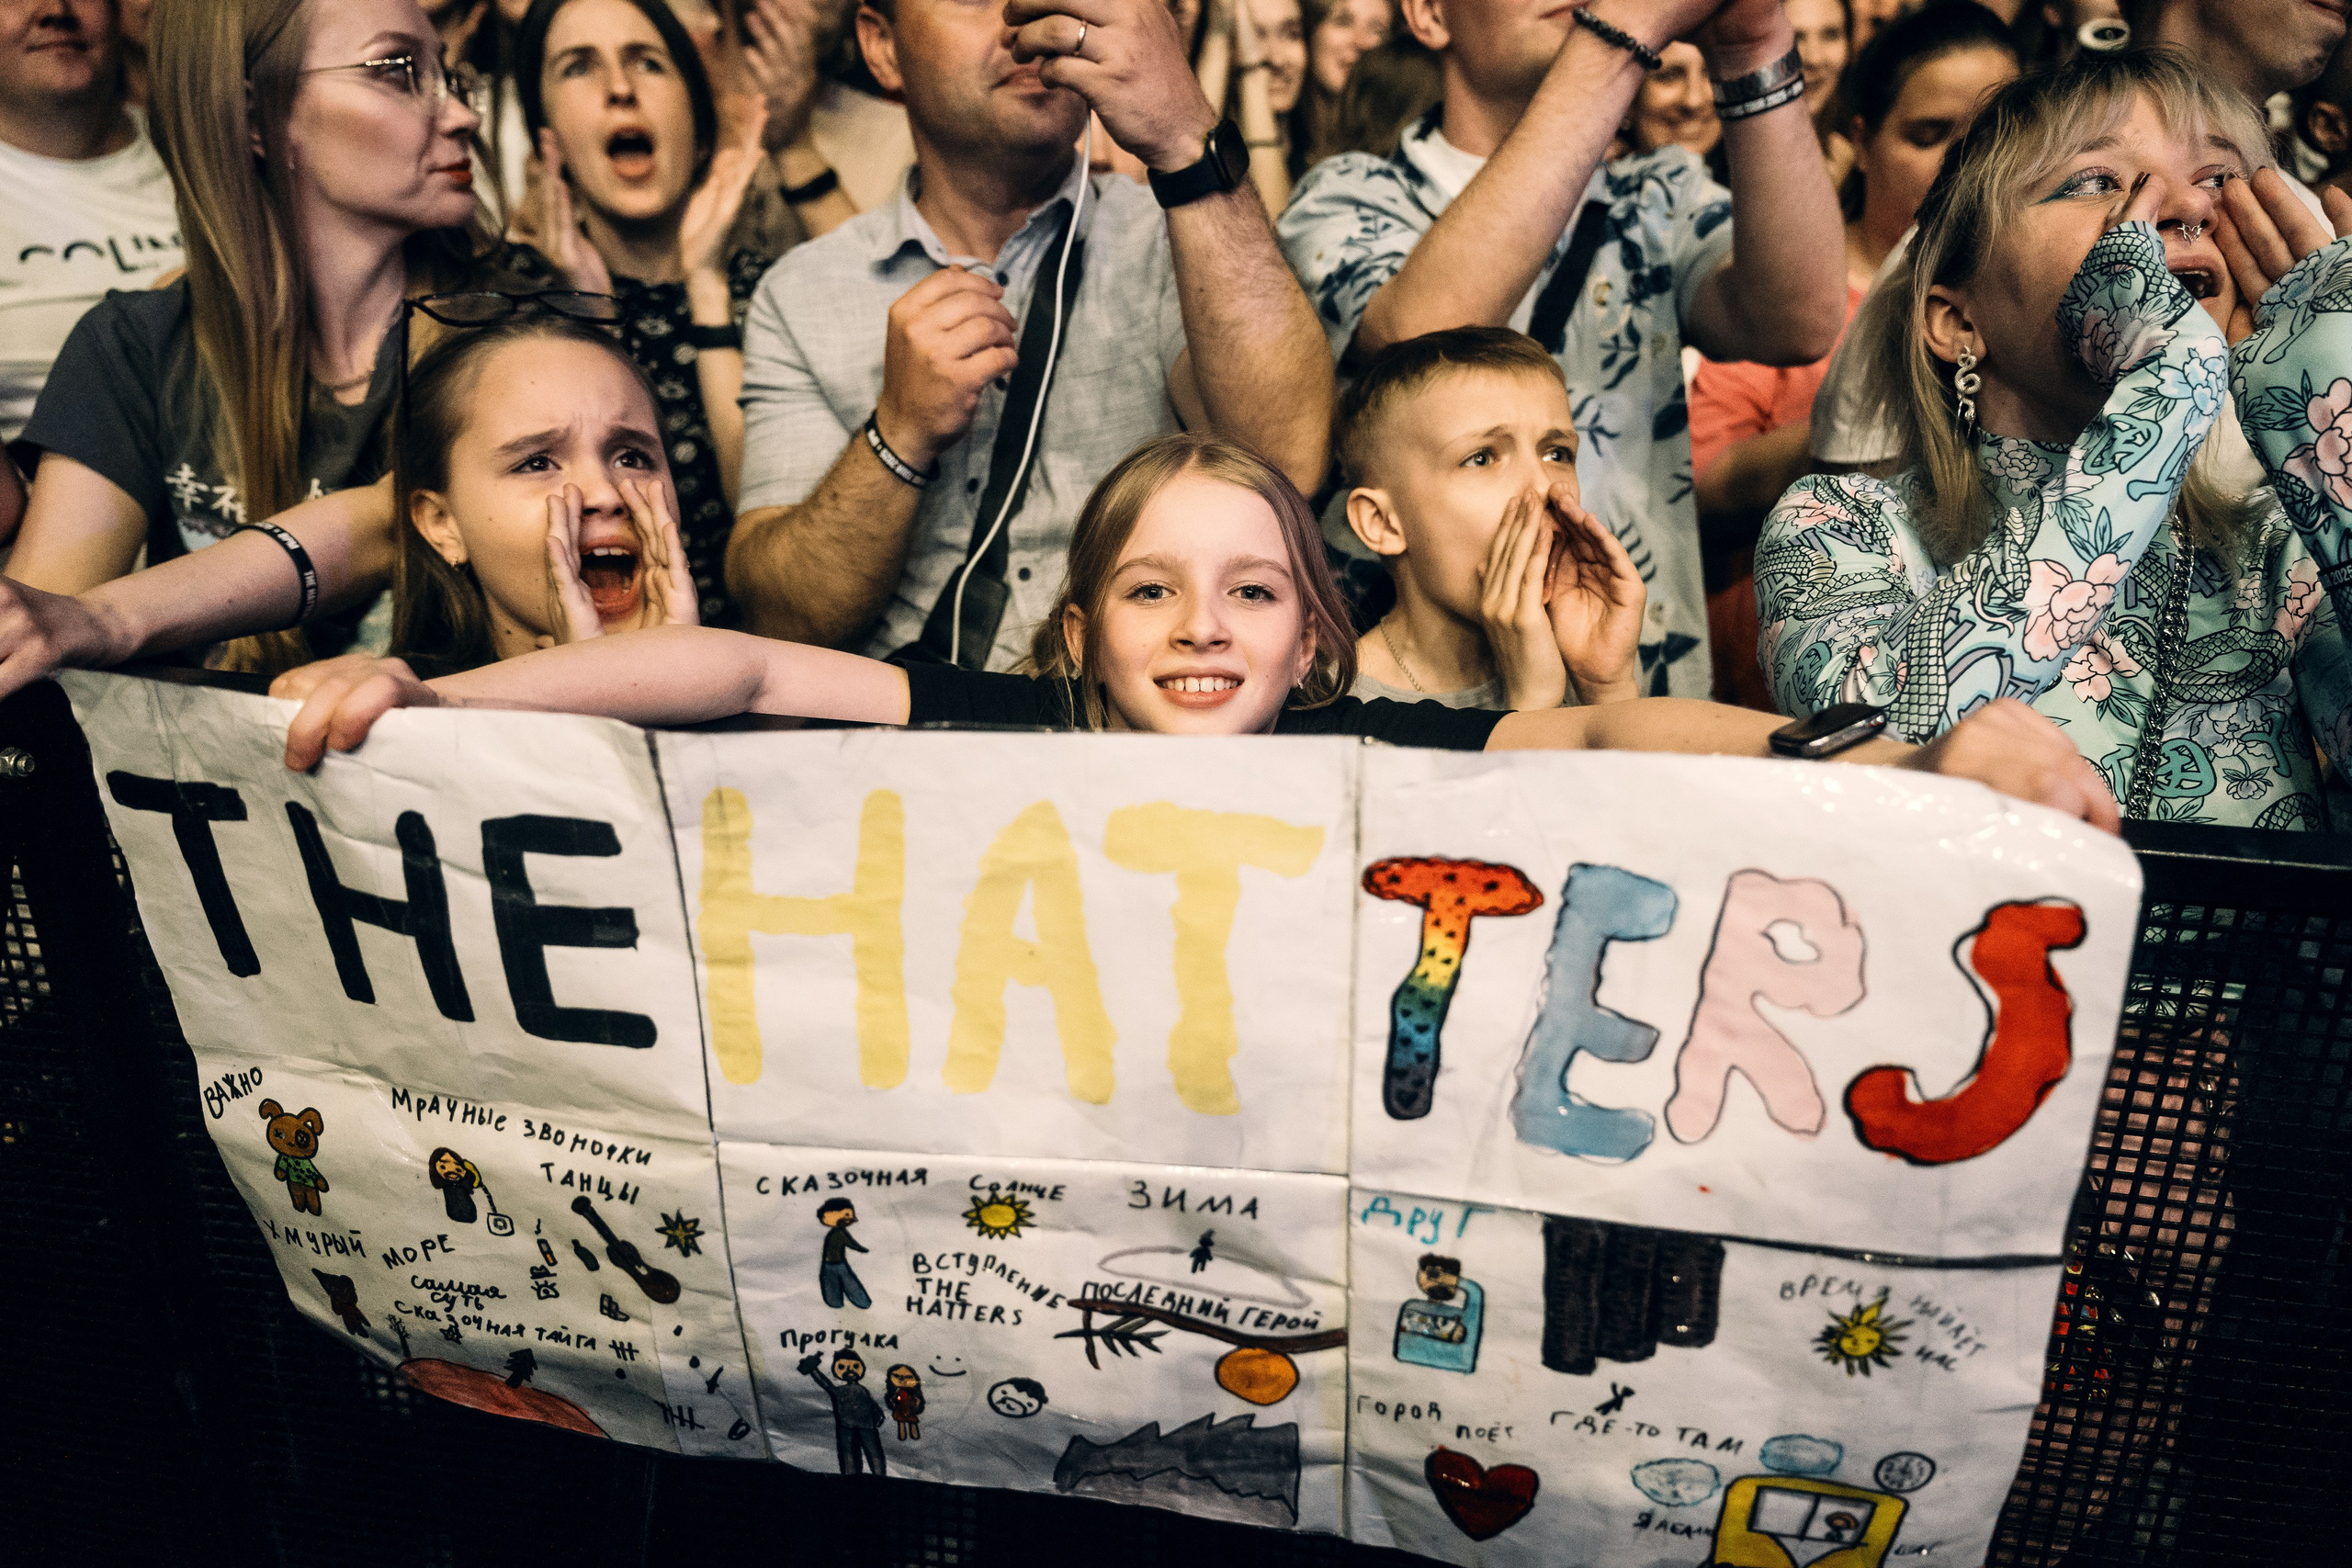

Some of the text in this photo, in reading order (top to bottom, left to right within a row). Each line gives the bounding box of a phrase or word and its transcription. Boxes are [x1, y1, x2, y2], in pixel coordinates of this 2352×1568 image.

[107, 768, 659, 1049] THE
[203, 1066, 264, 1120] ВАЖНО
[539, 1161, 640, 1205] ТАНЦЫ
[755, 1168, 928, 1196] СКАЗОЧНАЯ
[1127, 1179, 1259, 1220] ЗИМА
[381, 1234, 457, 1270] МОРЕ
[915, 1277, 972, 1303] THE
[905, 1294, 1024, 1327] HATTERS
[1675, 1426, 1746, 1456] ТАМ
